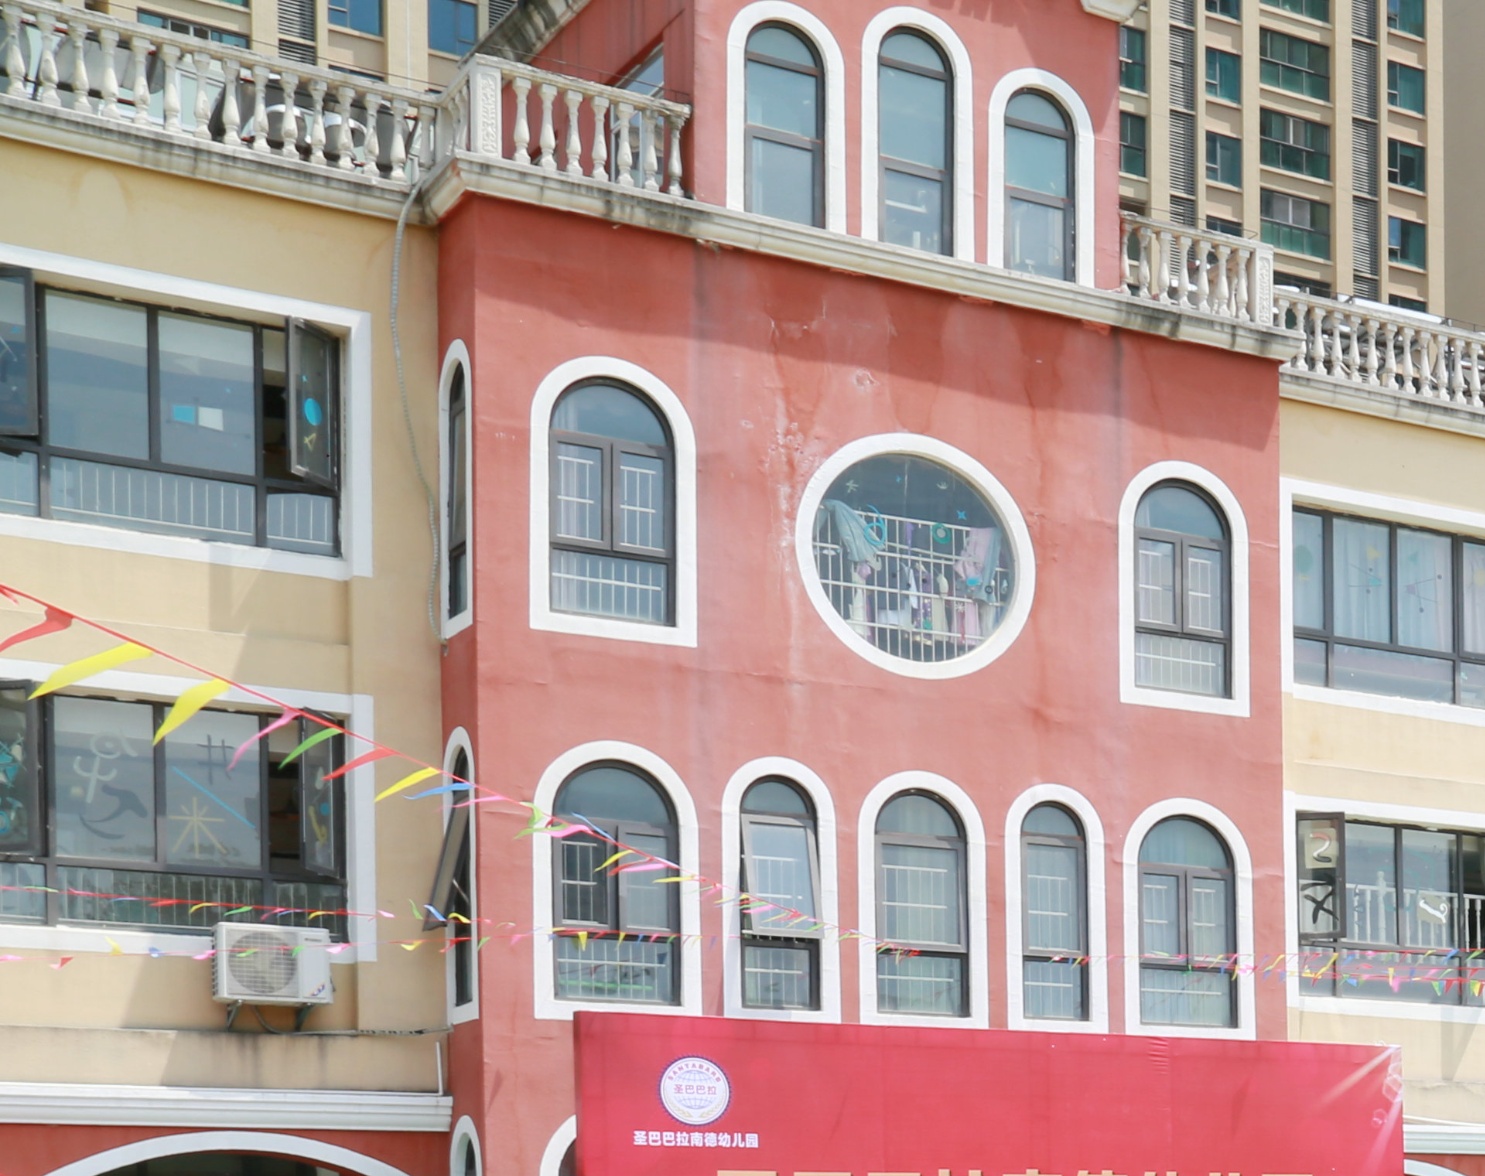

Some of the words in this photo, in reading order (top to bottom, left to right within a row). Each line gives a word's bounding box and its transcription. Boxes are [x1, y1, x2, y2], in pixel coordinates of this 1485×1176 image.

[673, 1084, 718, 1096] 圣巴巴拉
[633, 1130, 759, 1148] 圣巴巴拉南德幼儿园
